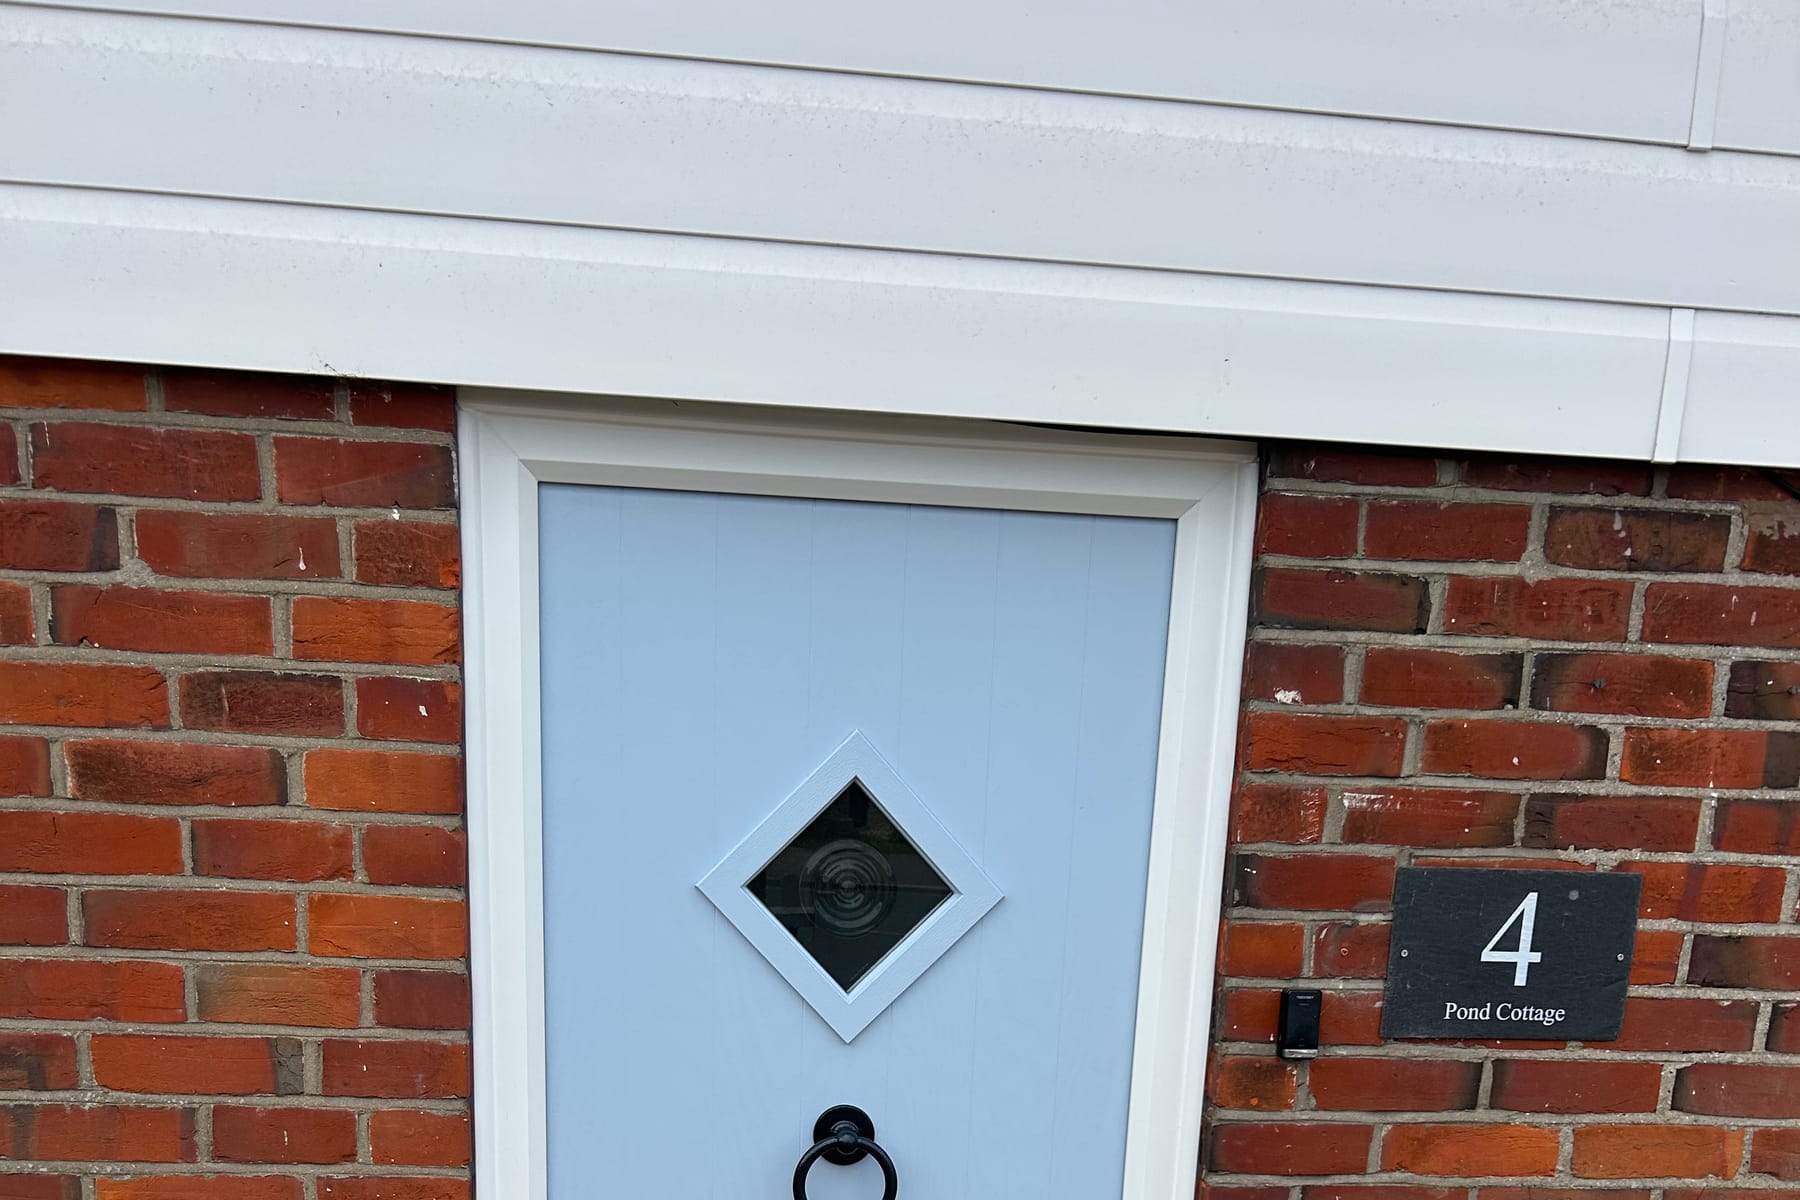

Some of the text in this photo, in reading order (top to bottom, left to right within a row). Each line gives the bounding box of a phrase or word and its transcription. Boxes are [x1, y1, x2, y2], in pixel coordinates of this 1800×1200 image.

[1480, 891, 1542, 987] 4
[1443, 1002, 1566, 1026] Pond Cottage
